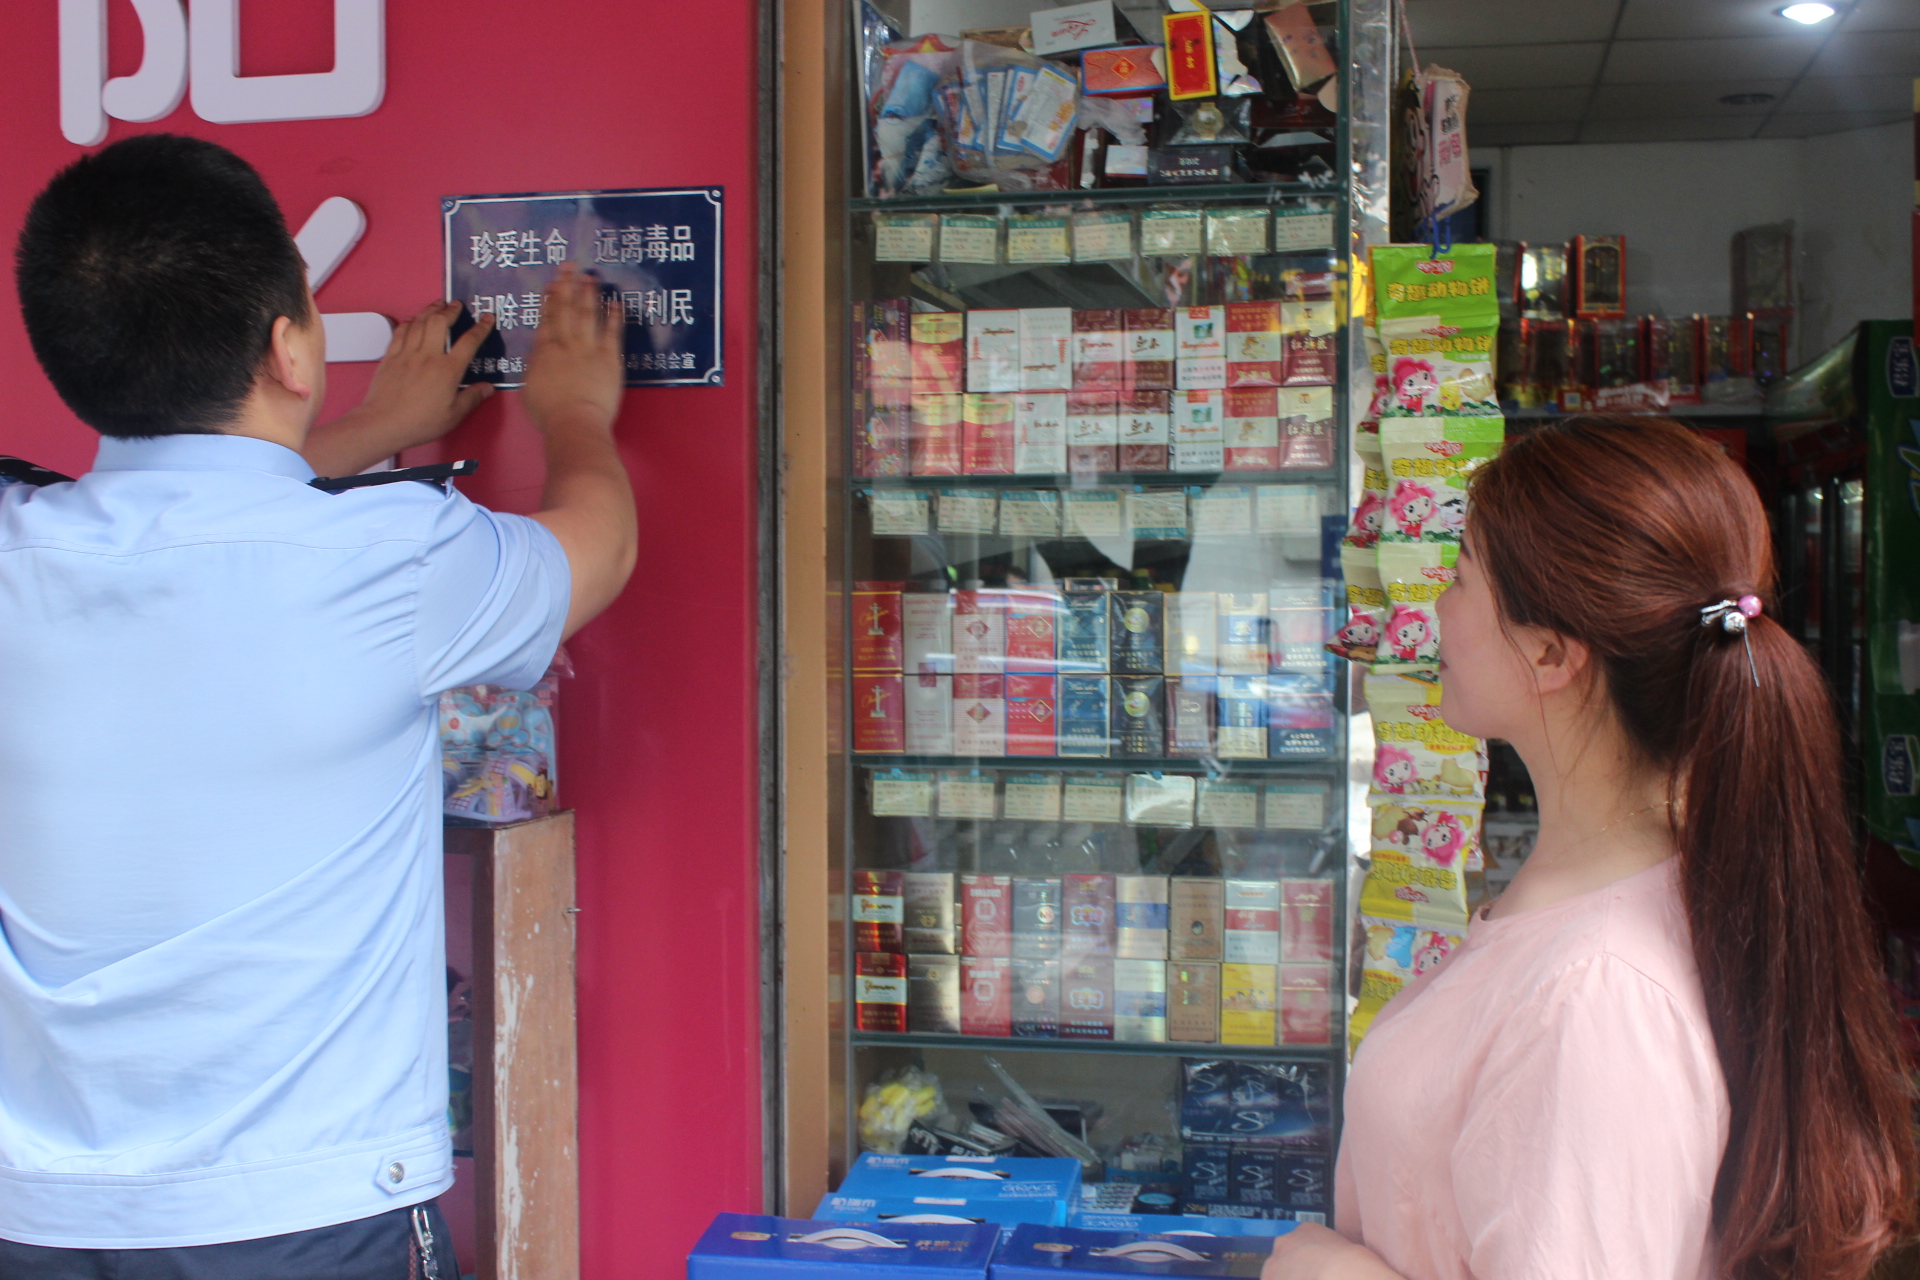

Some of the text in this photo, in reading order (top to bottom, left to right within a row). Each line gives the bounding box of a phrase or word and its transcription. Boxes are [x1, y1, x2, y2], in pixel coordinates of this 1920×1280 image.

[470, 224, 695, 269] 珍爱生命 远离毒品
[471, 291, 549, 331] 扫除毒
